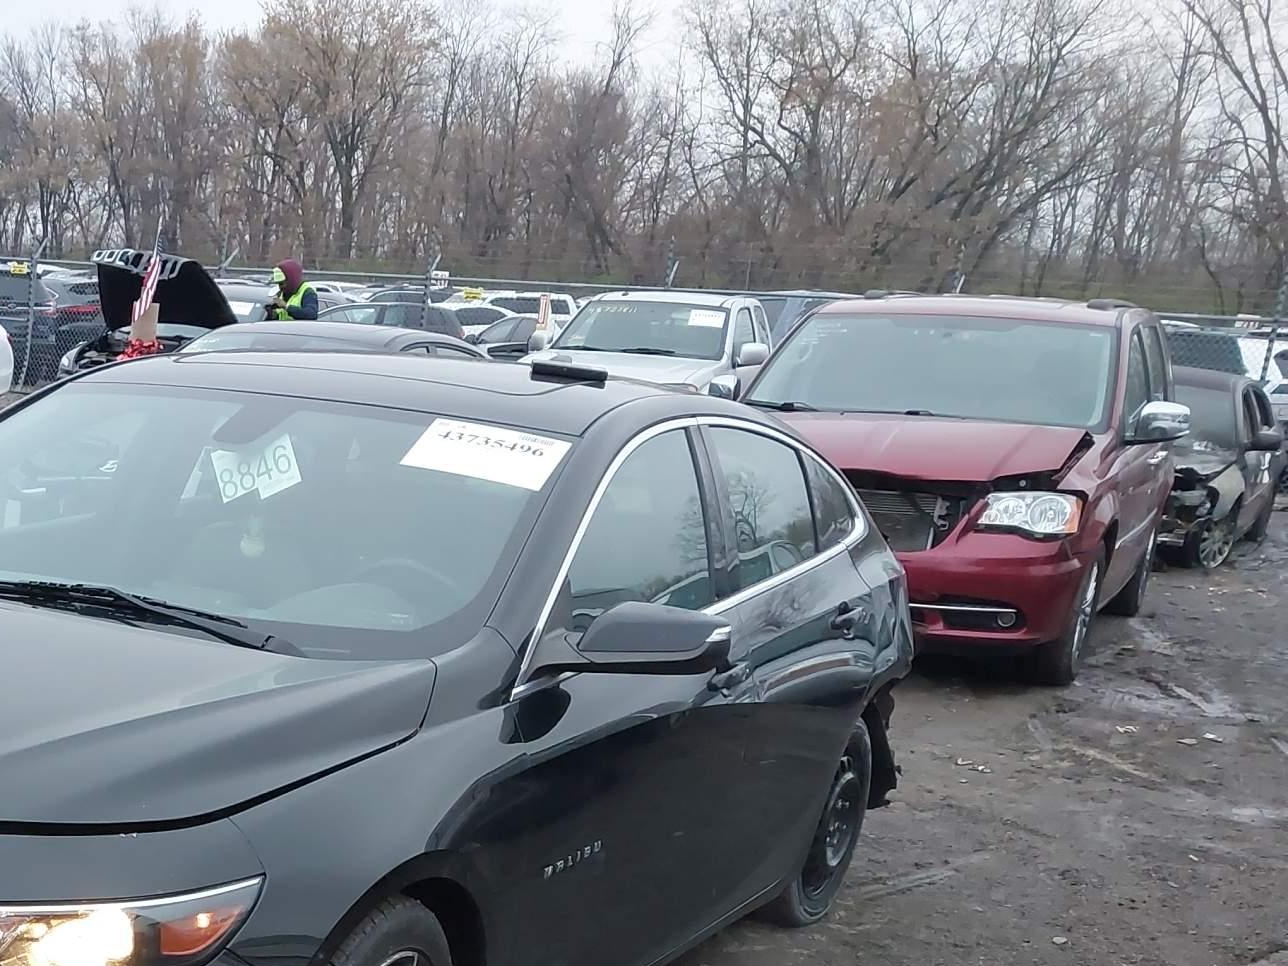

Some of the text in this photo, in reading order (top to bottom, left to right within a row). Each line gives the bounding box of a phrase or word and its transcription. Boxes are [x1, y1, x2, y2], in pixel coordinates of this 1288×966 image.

[437, 430, 545, 457] 43735496
[219, 444, 291, 499] 8846
[543, 839, 602, 880] MALIBU
